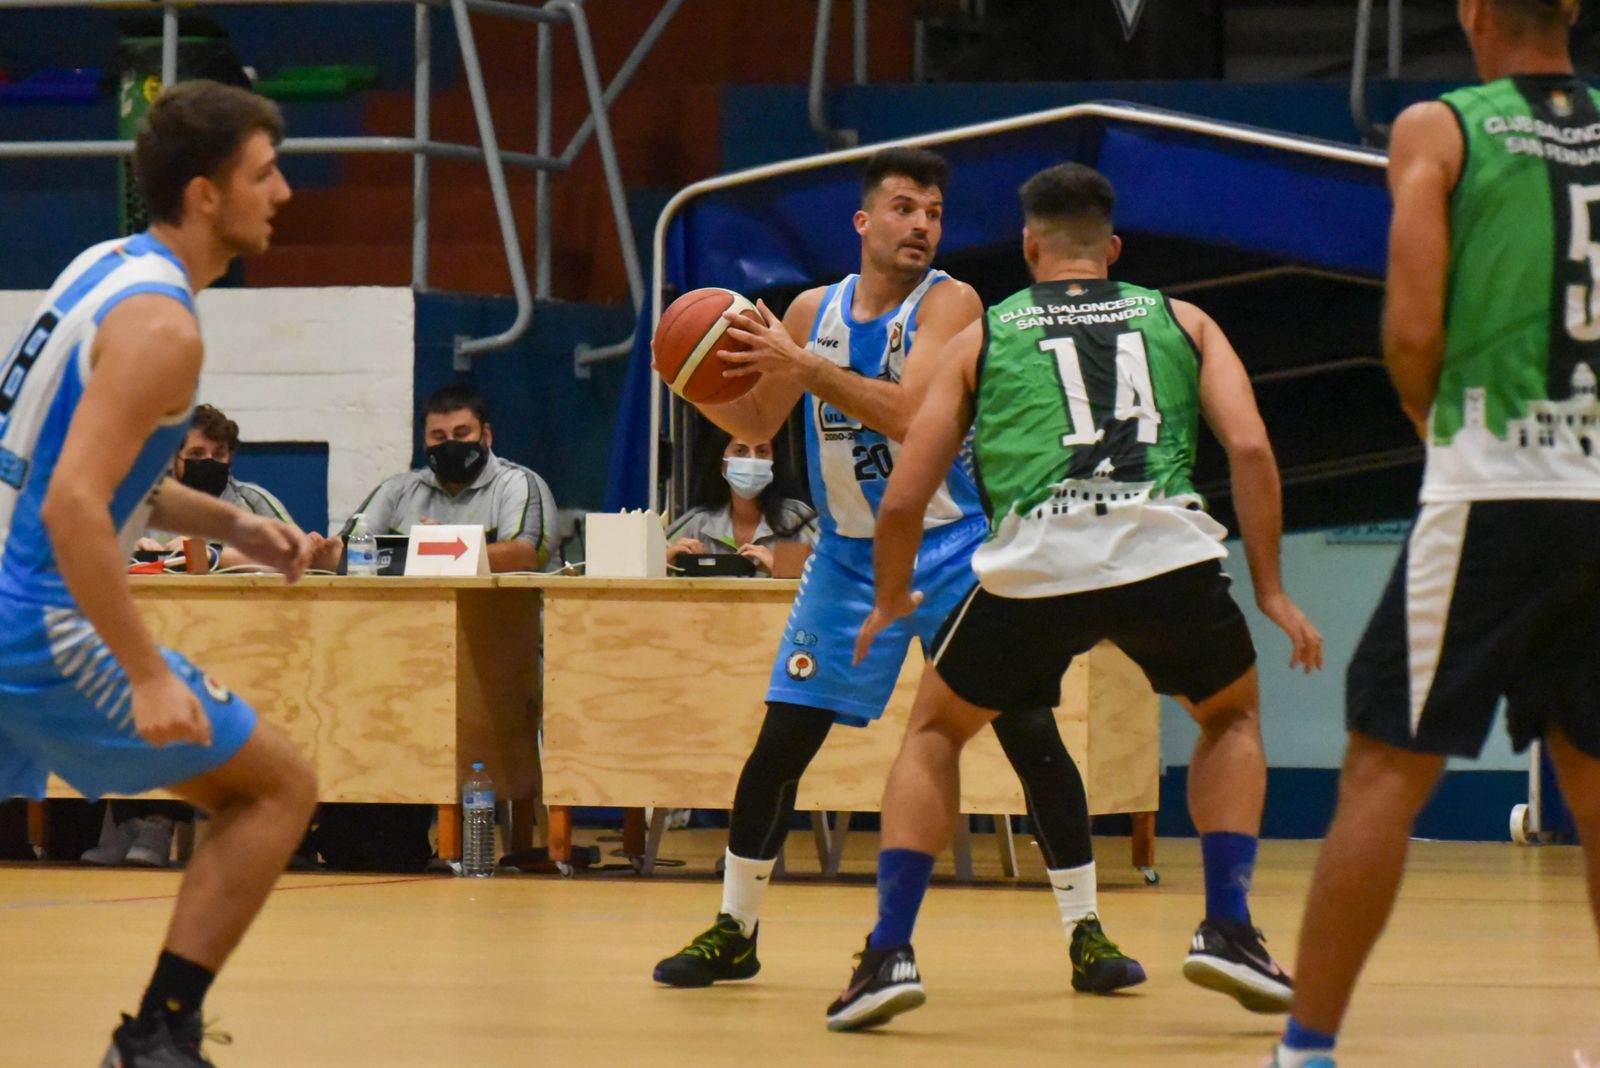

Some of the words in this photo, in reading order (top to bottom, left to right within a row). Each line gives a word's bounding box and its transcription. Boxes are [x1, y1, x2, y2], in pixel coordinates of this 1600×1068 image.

[999, 306, 1045, 323] CLUB
[1047, 295, 1157, 314] BALONCESTO
[1016, 315, 1053, 331] SAN
[1057, 307, 1148, 326] FERNANDO
[1038, 331, 1162, 447] 14
[852, 443, 894, 481] 20
